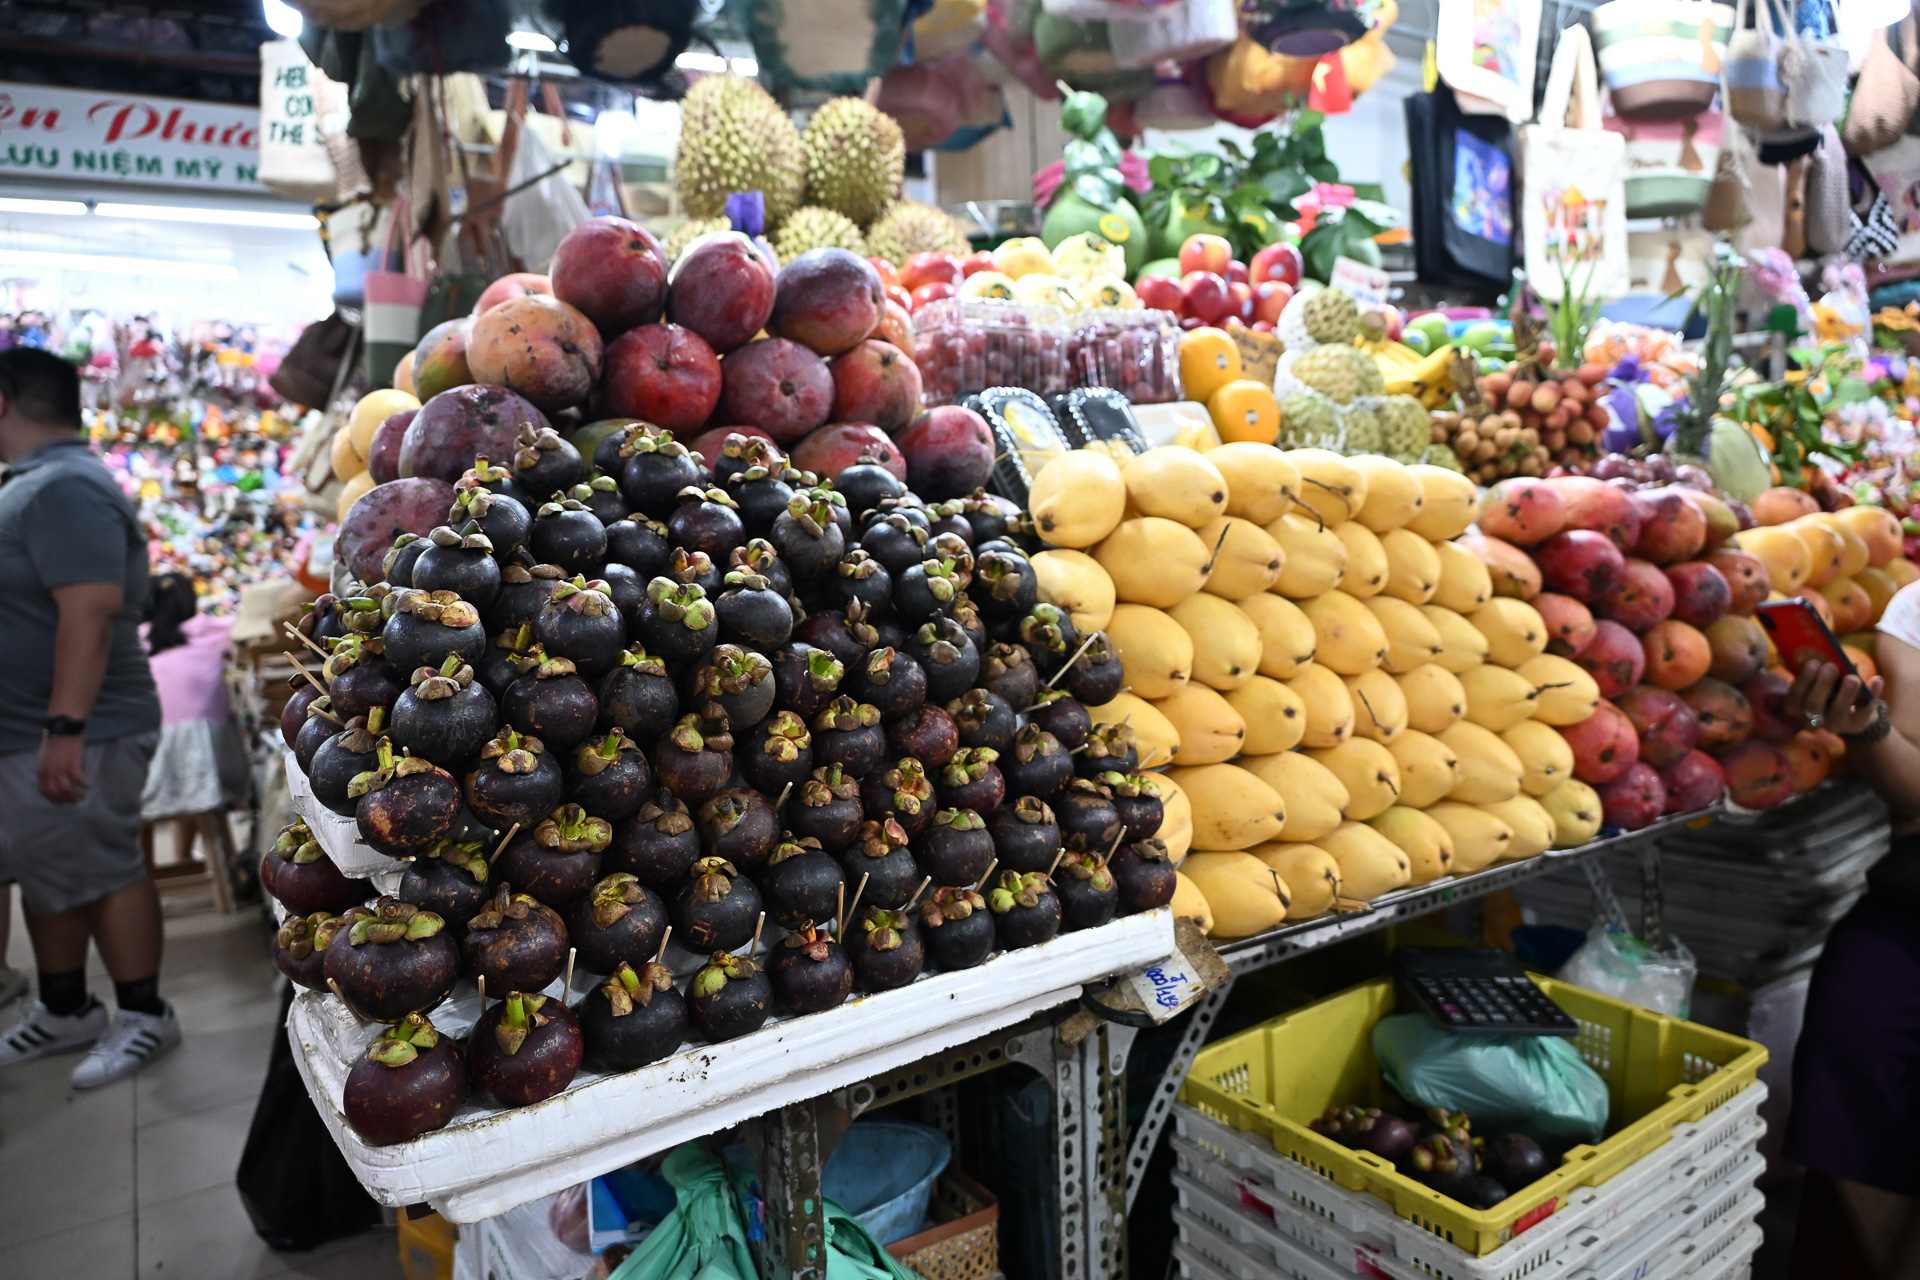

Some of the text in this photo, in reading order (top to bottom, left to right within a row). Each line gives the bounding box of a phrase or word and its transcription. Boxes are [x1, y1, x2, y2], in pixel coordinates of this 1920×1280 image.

[269, 121, 303, 145] THE
[73, 147, 162, 179] NIỆM
[175, 155, 222, 180] MỸ
